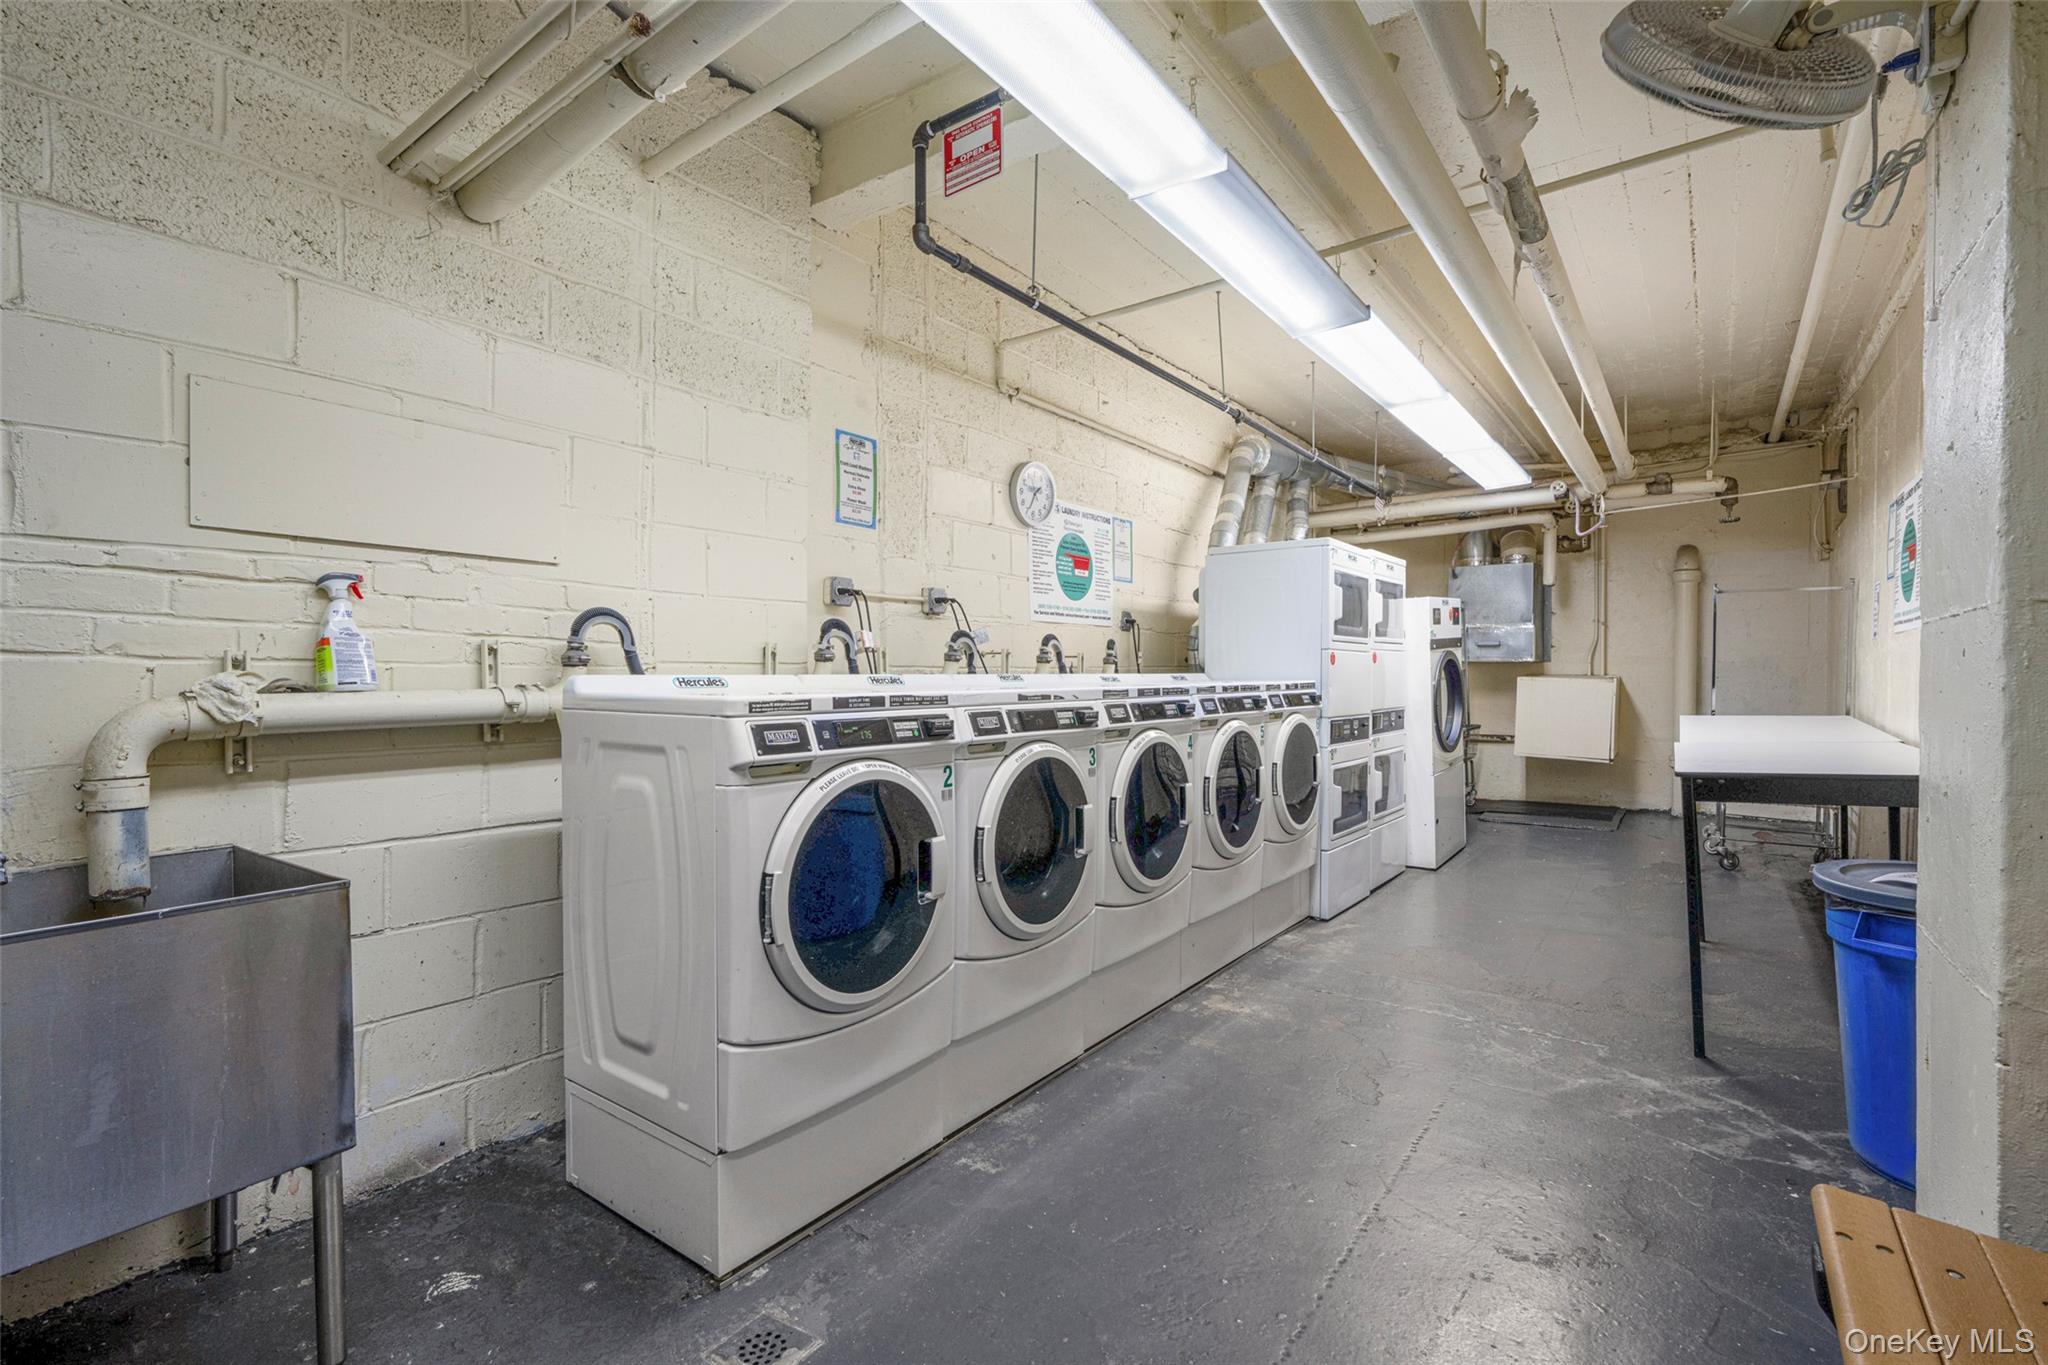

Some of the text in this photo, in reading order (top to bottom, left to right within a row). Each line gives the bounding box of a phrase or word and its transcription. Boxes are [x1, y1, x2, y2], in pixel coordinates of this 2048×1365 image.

[960, 145, 985, 162] OPEN
[1062, 506, 1080, 518] LAUNDRY
[1082, 512, 1111, 525] INSTRUCTIONS
[676, 677, 725, 687] Hercules
[868, 676, 903, 684] Hercules
[767, 731, 797, 740] MAYTAG
[1089, 747, 1096, 766] 3
[819, 777, 836, 792] PLEASE
[836, 769, 852, 780] LEAVE
[943, 765, 953, 788] 2
